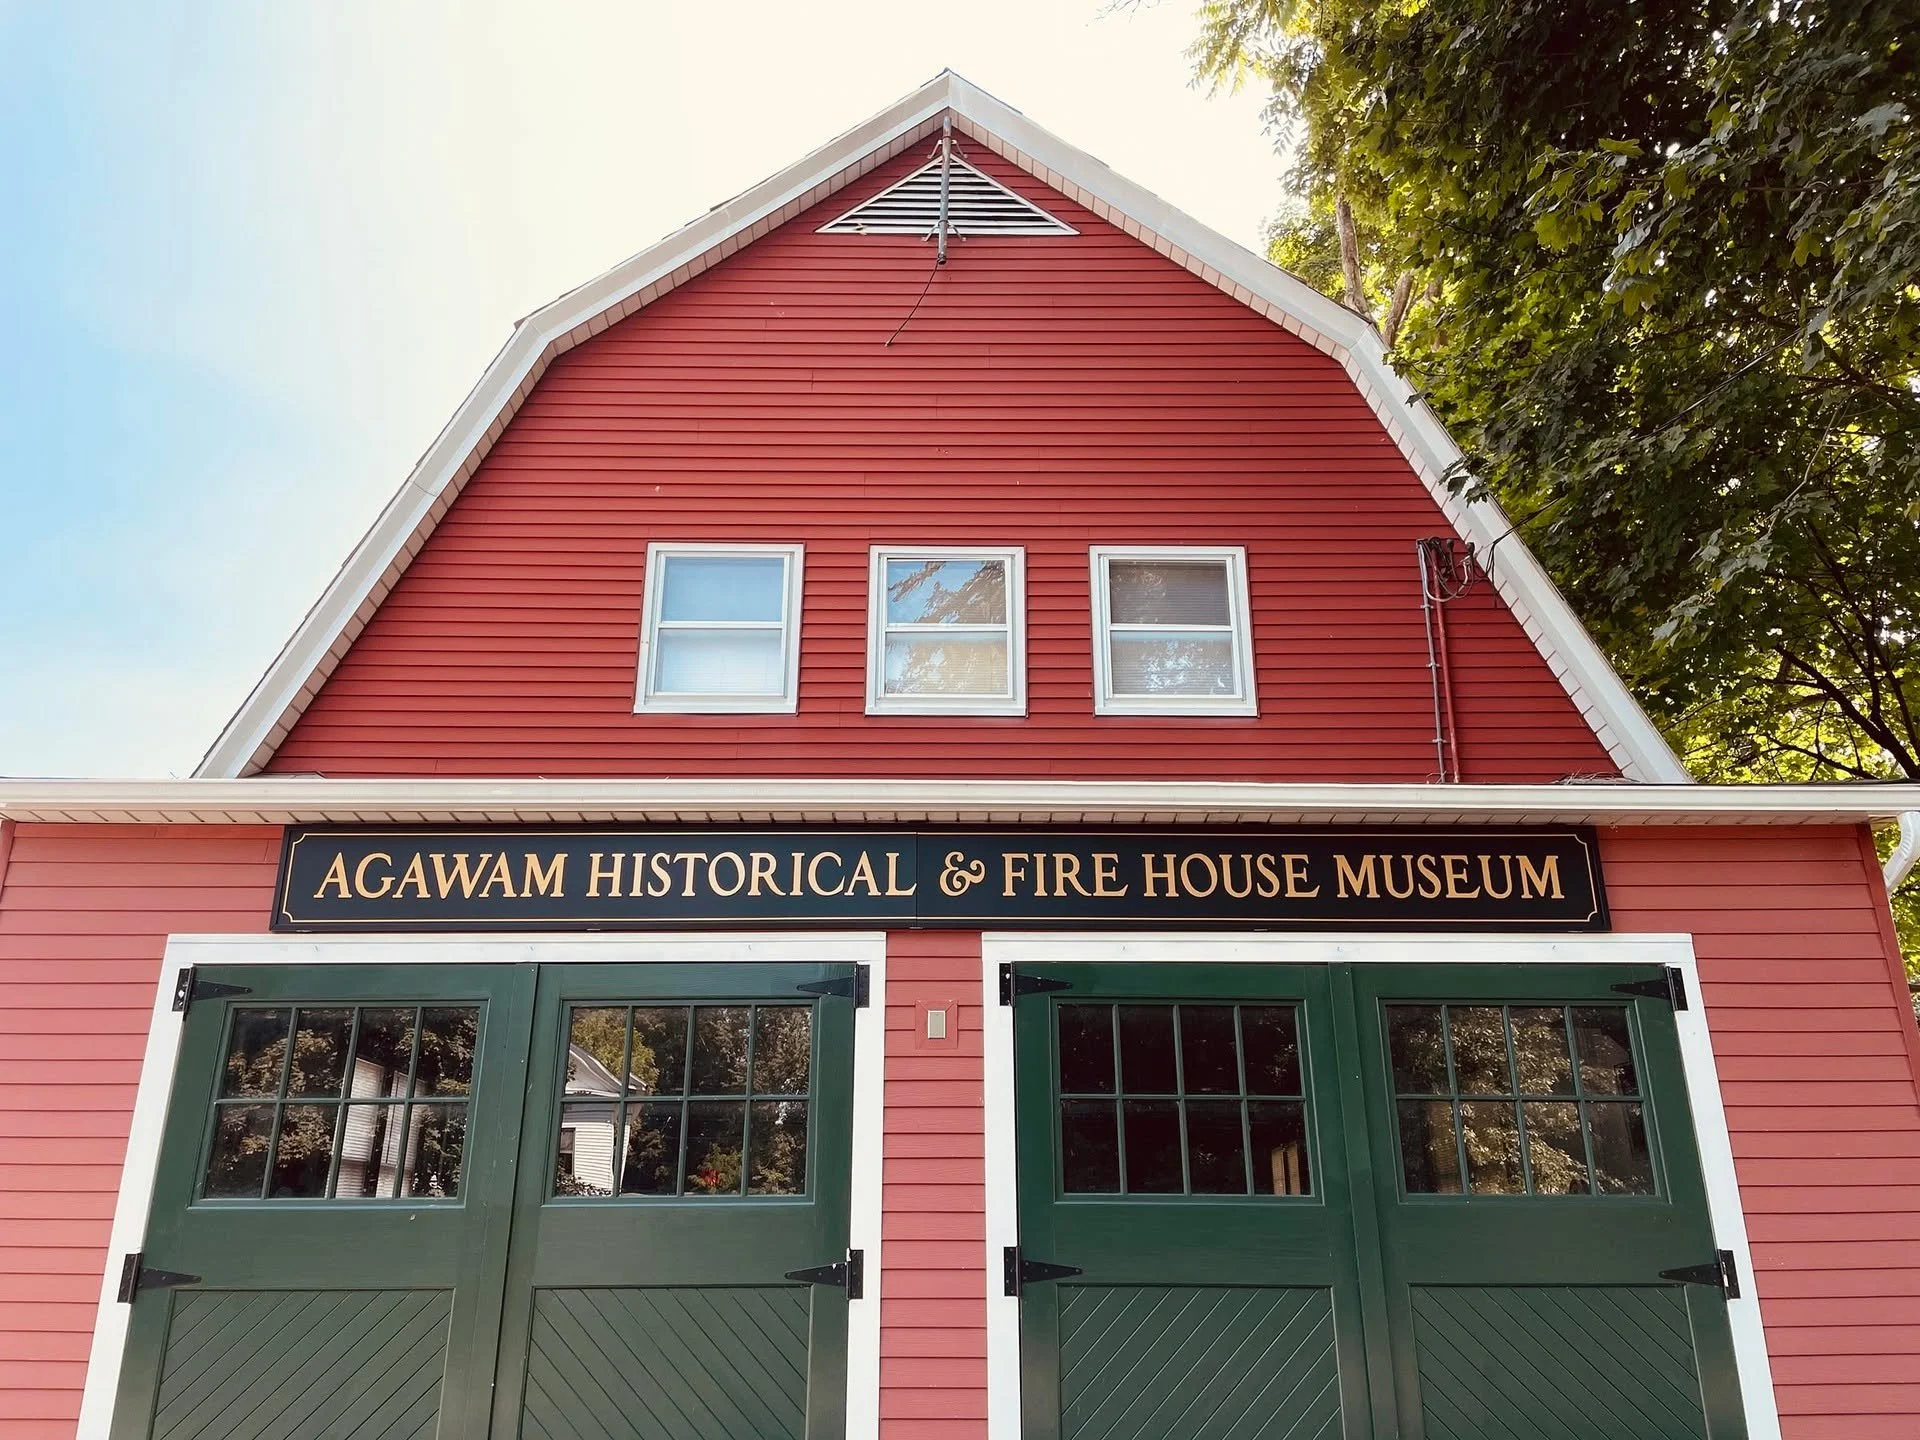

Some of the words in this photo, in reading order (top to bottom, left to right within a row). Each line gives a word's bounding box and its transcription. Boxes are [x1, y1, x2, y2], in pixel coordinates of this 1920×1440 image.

[313, 852, 568, 899] AGAWAM
[586, 851, 917, 897] HISTORICAL
[939, 851, 985, 896] &
[1002, 853, 1128, 896] FIRE
[1142, 853, 1320, 897] HOUSE
[1333, 854, 1564, 899] MUSEUM
